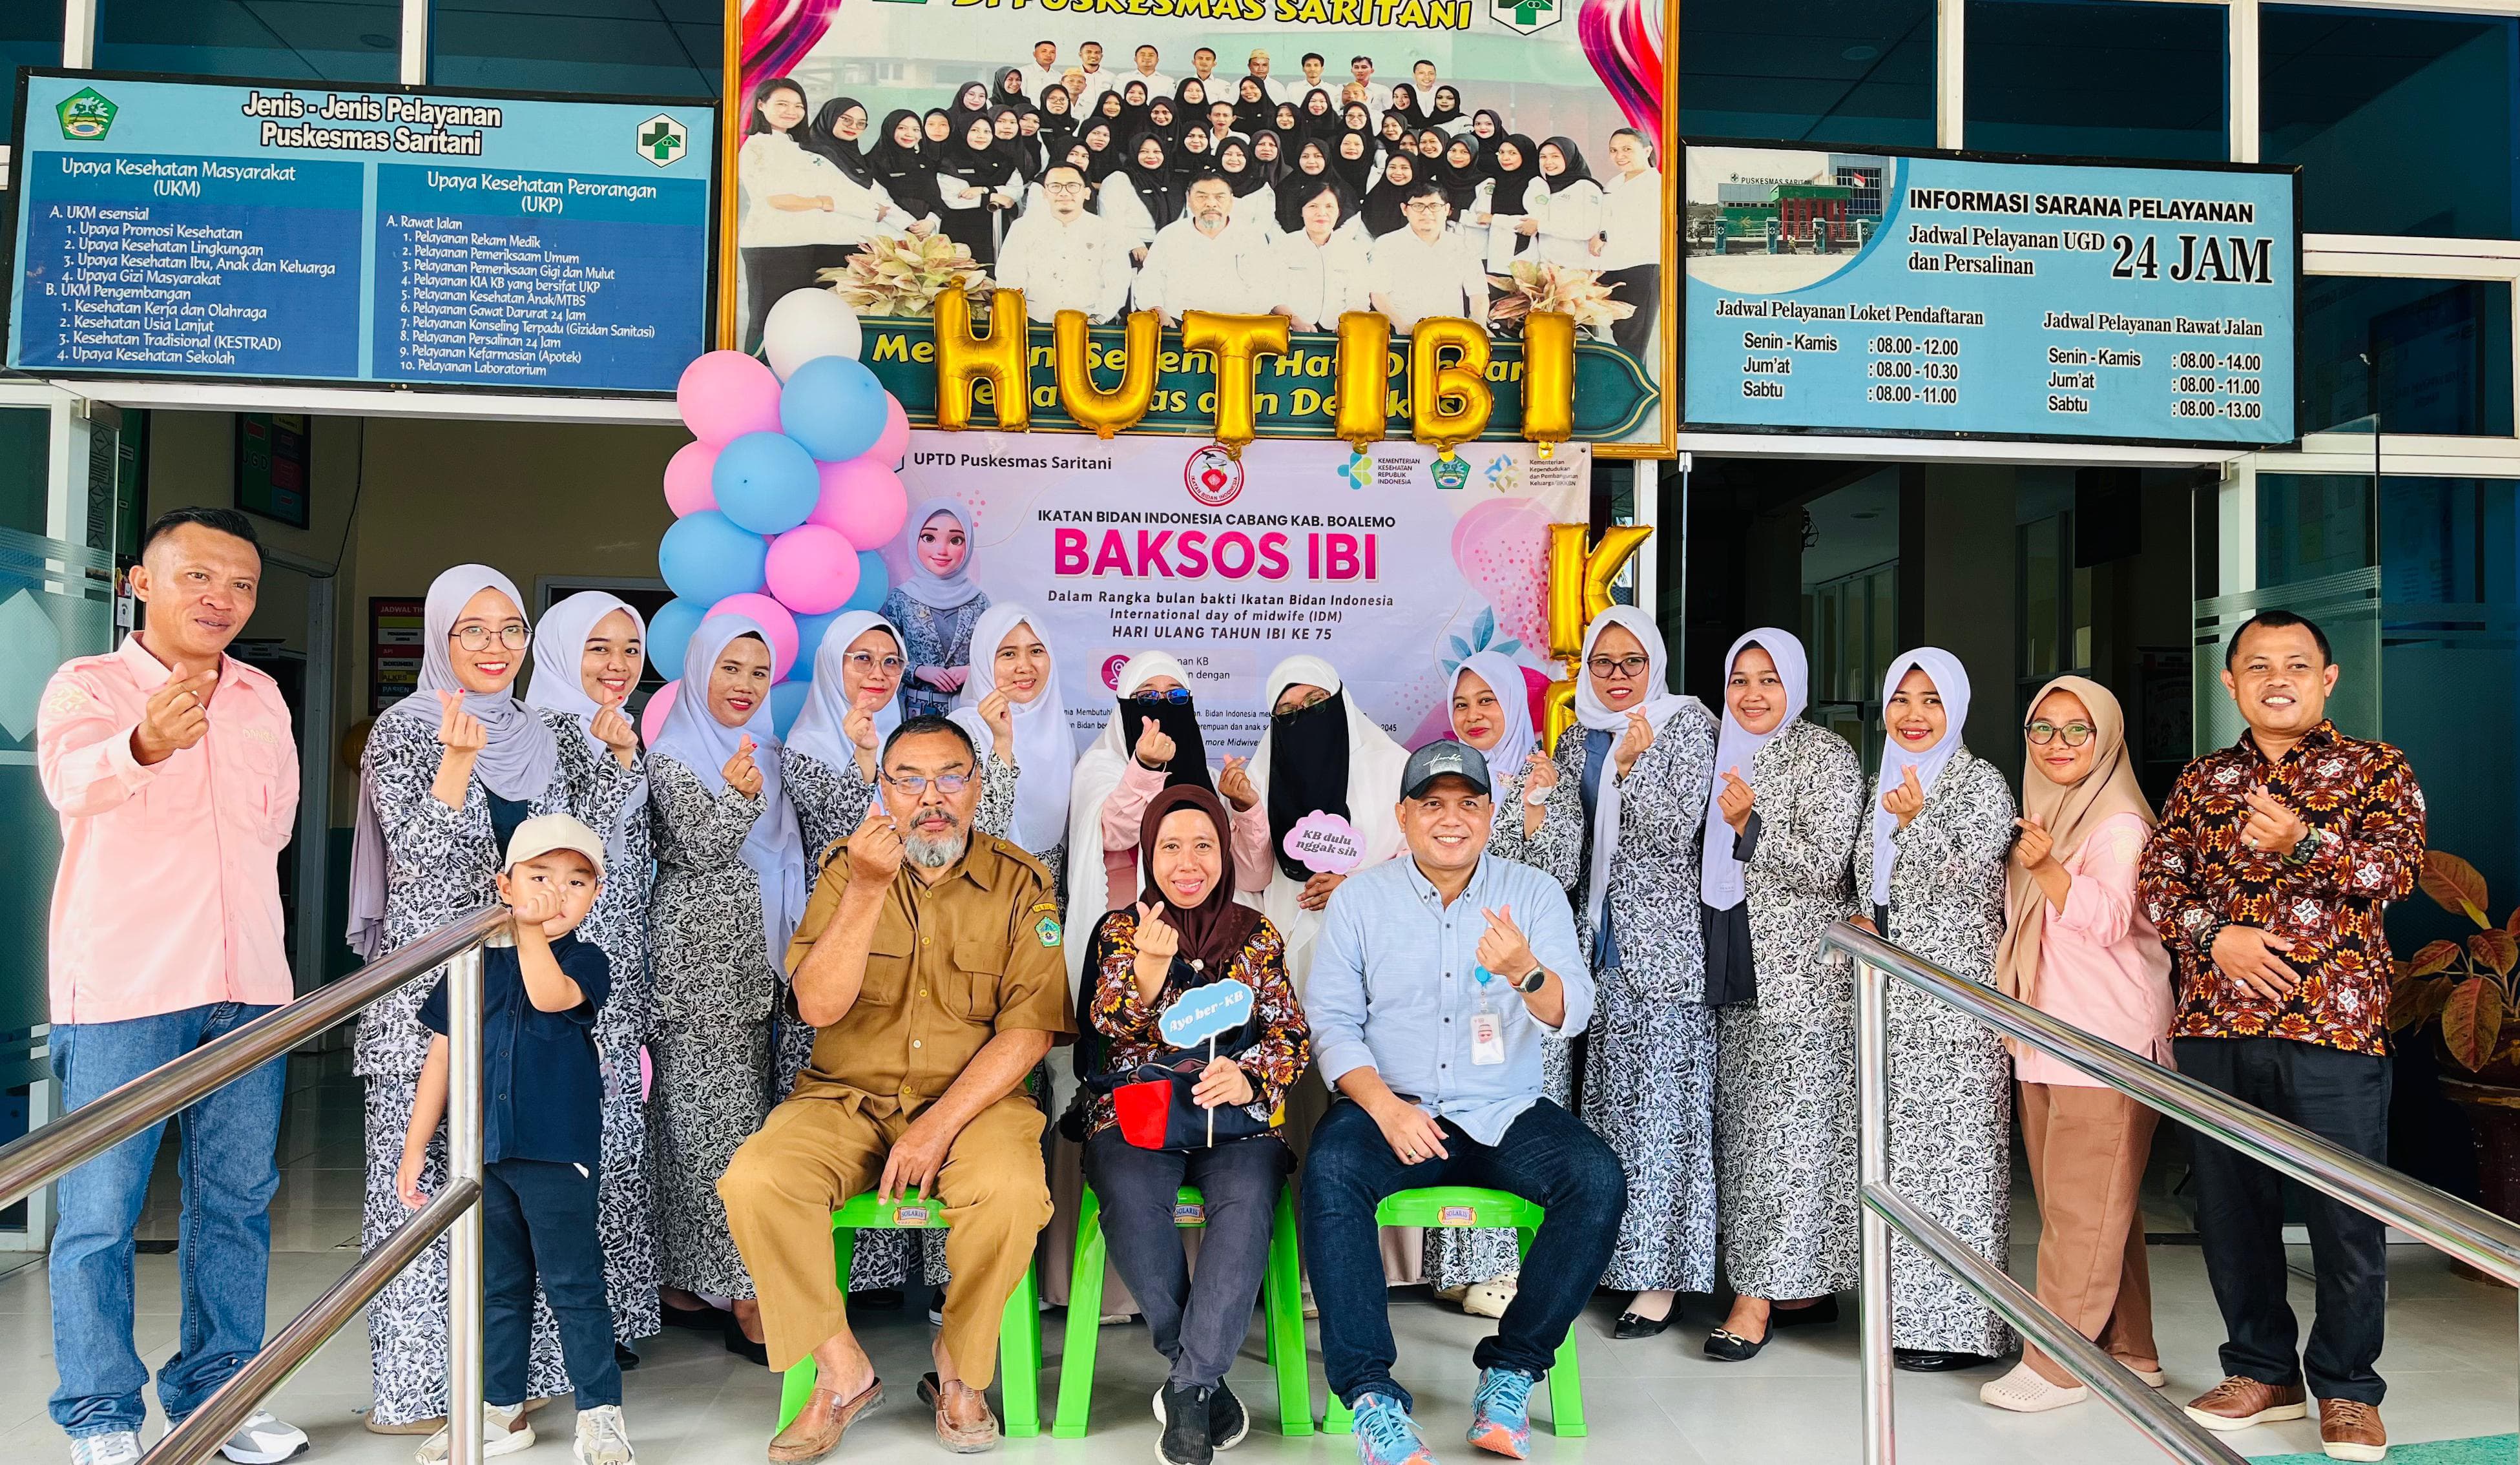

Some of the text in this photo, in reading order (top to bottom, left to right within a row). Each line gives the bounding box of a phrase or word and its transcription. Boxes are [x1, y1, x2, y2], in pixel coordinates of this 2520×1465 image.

[1275, 0, 1472, 30] SARITANI
[243, 92, 305, 118] Jenis
[320, 95, 382, 121] Jenis
[386, 97, 502, 129] Pelayanan
[261, 122, 482, 156] Puskesmas Saritani
[62, 158, 296, 182] Upaya Kesehatan Masyarakat
[154, 180, 200, 198] (UKM)
[428, 171, 656, 202] Upaya Kesehatan Perorangan
[49, 205, 149, 220] A. UKM esensial
[521, 196, 563, 214] (UKP)
[1911, 189, 2253, 222] INFORMASI SARANA PELAYANAN
[67, 222, 242, 240] 1. Upaya Promosi Kesehatan
[386, 215, 463, 230] A. Rawat Jalan
[65, 237, 264, 257] 2. Upaya Kesehatan Lingkungan
[403, 230, 541, 248] 1. Pelayanan Rekam Medik
[1909, 225, 2105, 252] Jadwal Pelayanan UGD
[1909, 252, 2034, 275] dan Persalinan
[2112, 235, 2273, 283] 24 JAM
[46, 283, 191, 301] B. UKM Pengembangan
[401, 301, 586, 322] 6. Pelayanan Gawat Darurat 24 Jam
[1716, 300, 1983, 324] Jadwal Pelayanan Loket Pendaftaran
[2044, 313, 2262, 336] Jadwal Pelayanan Rawat Jalan
[59, 330, 282, 351] 3. Kesehatan Tradisional (KESTRAD)
[1744, 332, 1783, 349] Senin
[1795, 334, 1837, 351] Kamis
[1877, 337, 1912, 353] 08.00
[1924, 339, 1958, 355] 12.00
[915, 453, 1111, 469] UPTD Puskesmas Saritani
[1039, 510, 1395, 527] IKATAN BIDAN INDONESIA CABANG KAB. BOALEMO
[1054, 527, 1379, 581] BAKSOS IBI
[1048, 590, 1393, 606] Dalam Rangka bulan bakti Ikatan Bidan Indonesia
[1110, 608, 1342, 623] International day of midwife (IDM)
[1112, 625, 1331, 639] HARI ULANG TAHUN IBI KE 75
[1196, 656, 1209, 666] KB
[1196, 670, 1230, 681] dengan
[1225, 709, 1256, 718] Indonesia
[1302, 830, 1352, 846] KB dulu
[1296, 840, 1357, 857] nggak sih
[1170, 990, 1244, 1033] Ayo ber-KB
[1176, 1207, 1198, 1216] SOLARIS
[1446, 1210, 1468, 1218] SOLARIS
